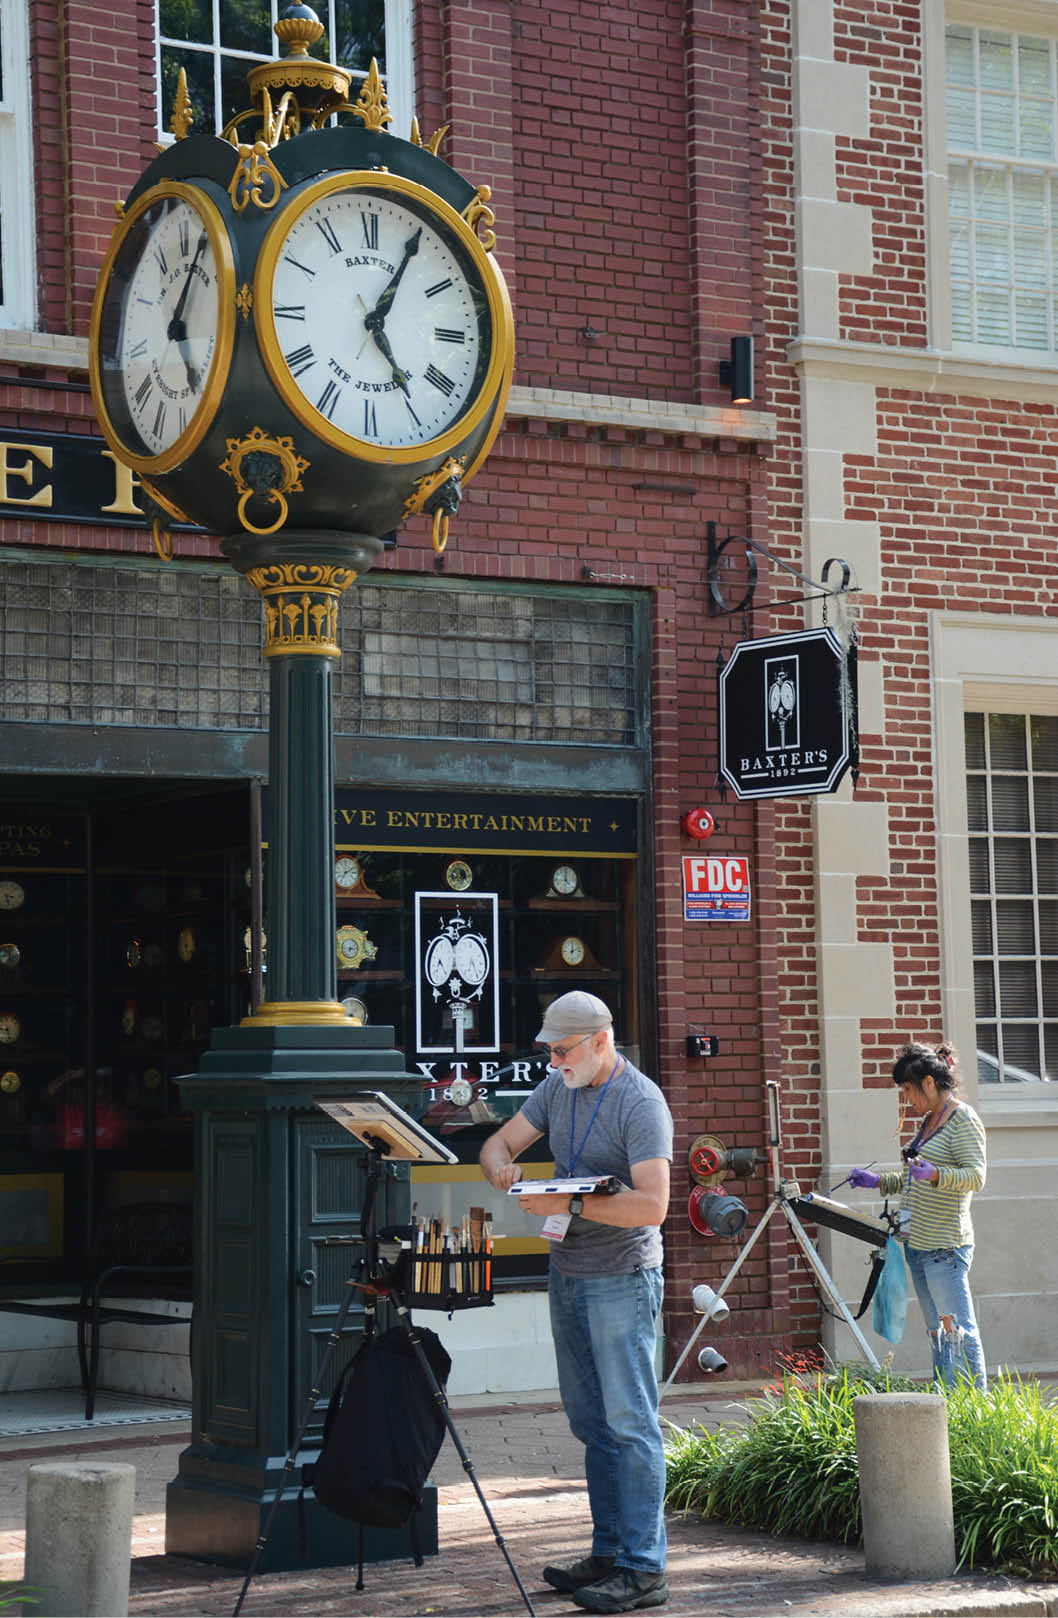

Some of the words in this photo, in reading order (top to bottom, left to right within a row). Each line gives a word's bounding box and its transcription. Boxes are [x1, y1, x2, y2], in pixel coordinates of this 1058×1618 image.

[345, 256, 396, 274] BAXTER
[328, 357, 350, 384] THE
[740, 749, 828, 771] BAXTER'S
[770, 767, 797, 779] 1892
[386, 810, 592, 833] ENTERTAINMENT
[690, 859, 743, 892] FDC
[429, 1087, 489, 1101] 1892
